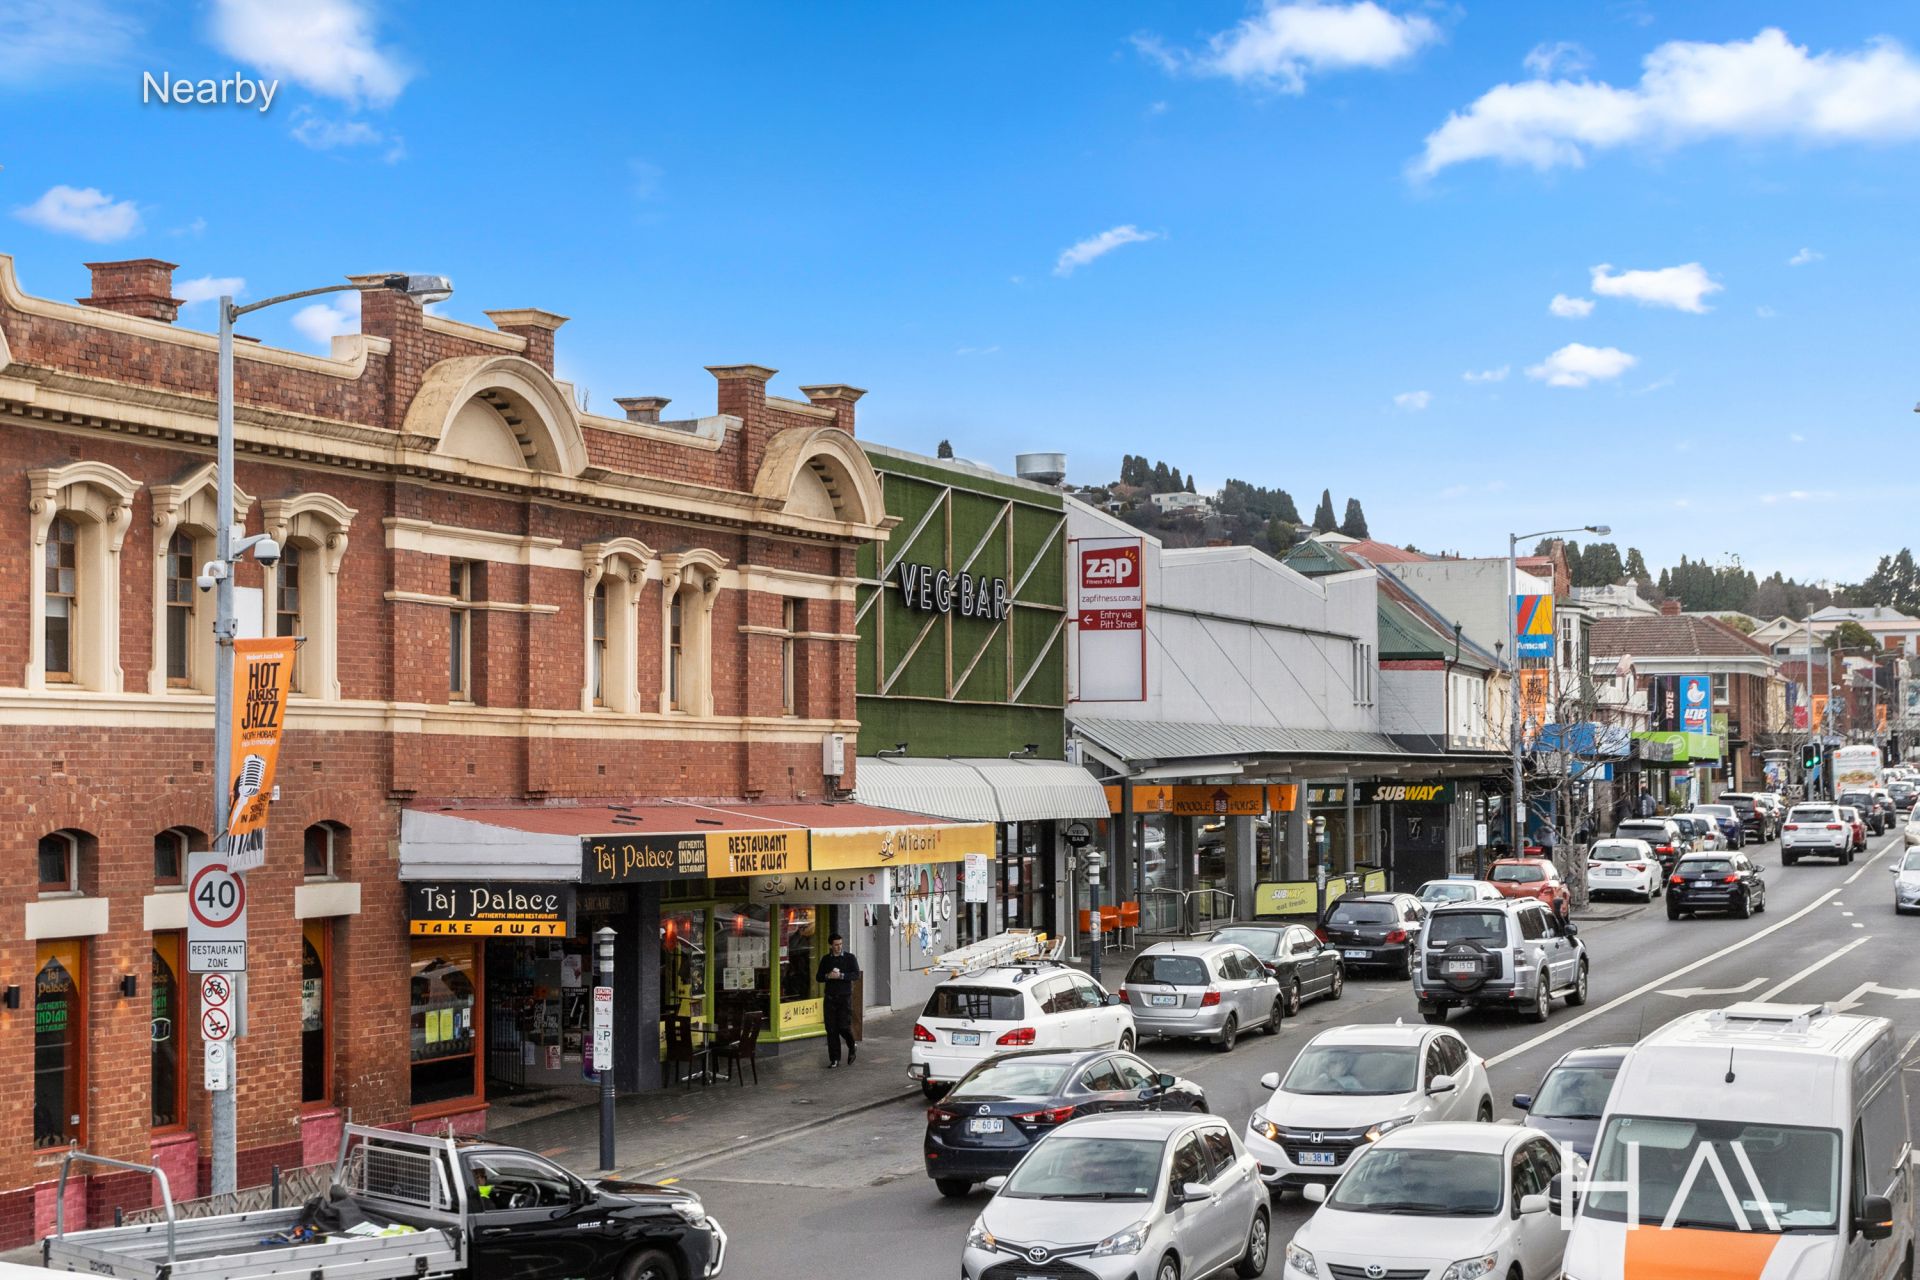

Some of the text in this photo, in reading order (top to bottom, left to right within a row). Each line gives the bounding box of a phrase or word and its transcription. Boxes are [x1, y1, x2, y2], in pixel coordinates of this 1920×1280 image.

[1086, 557, 1133, 584] zap
[901, 562, 1007, 620] VEG BAR
[1082, 594, 1140, 604] zapfitness.com.au
[1100, 610, 1132, 620] Entry via
[1100, 620, 1138, 629] Pitt Street
[249, 662, 280, 690] HOT
[247, 688, 279, 702] AUGUST
[1665, 691, 1674, 719] TASTE
[241, 700, 279, 730] JAZZ
[1372, 785, 1444, 801] SUBWAY
[678, 840, 704, 850] AUTHENTIC
[729, 834, 787, 854] RESTAURANT
[898, 834, 936, 851] Midori
[593, 844, 675, 879] Taj Palace
[679, 850, 705, 865] INDIAN
[735, 853, 758, 873] TAKE
[760, 852, 788, 870] AWAY
[679, 864, 705, 874] RESTAURANT
[795, 876, 864, 891] Midori
[198, 881, 235, 908] 40
[1272, 889, 1304, 899] SUBWAY
[420, 886, 559, 918] Taj Palace
[419, 923, 557, 934] TAKE AWAY
[192, 945, 243, 955] RESTAURANT
[207, 958, 228, 967] ZONE
[45, 968, 59, 983] Taj
[37, 982, 68, 997] Palace
[36, 1010, 67, 1025] INDIAN
[793, 1004, 816, 1016] Midori
